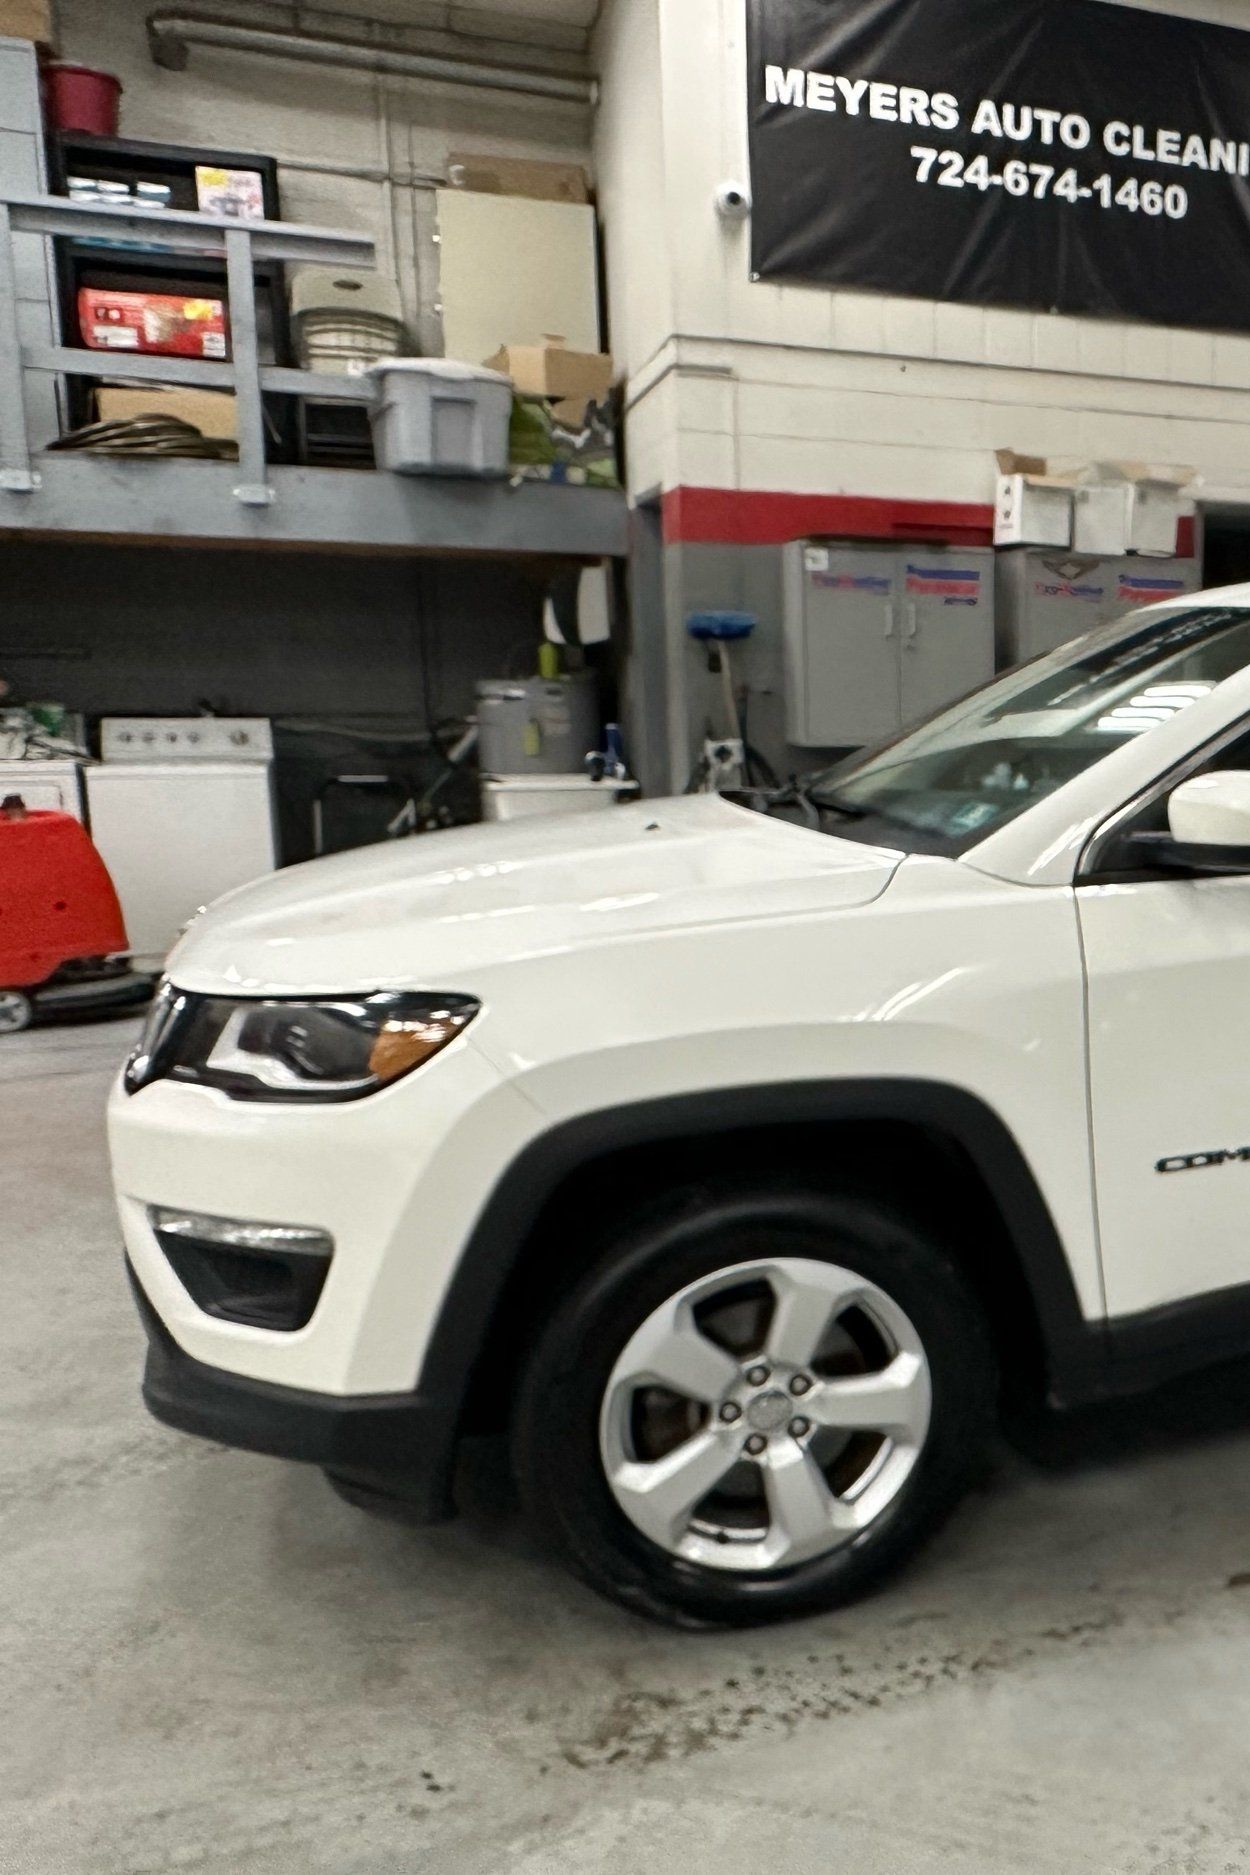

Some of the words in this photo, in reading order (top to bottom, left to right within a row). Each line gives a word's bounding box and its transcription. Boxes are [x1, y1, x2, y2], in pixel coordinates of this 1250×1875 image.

[764, 64, 960, 130] MEYERS
[970, 99, 1091, 150] AUTO
[910, 145, 1188, 219] 724-674-1460
